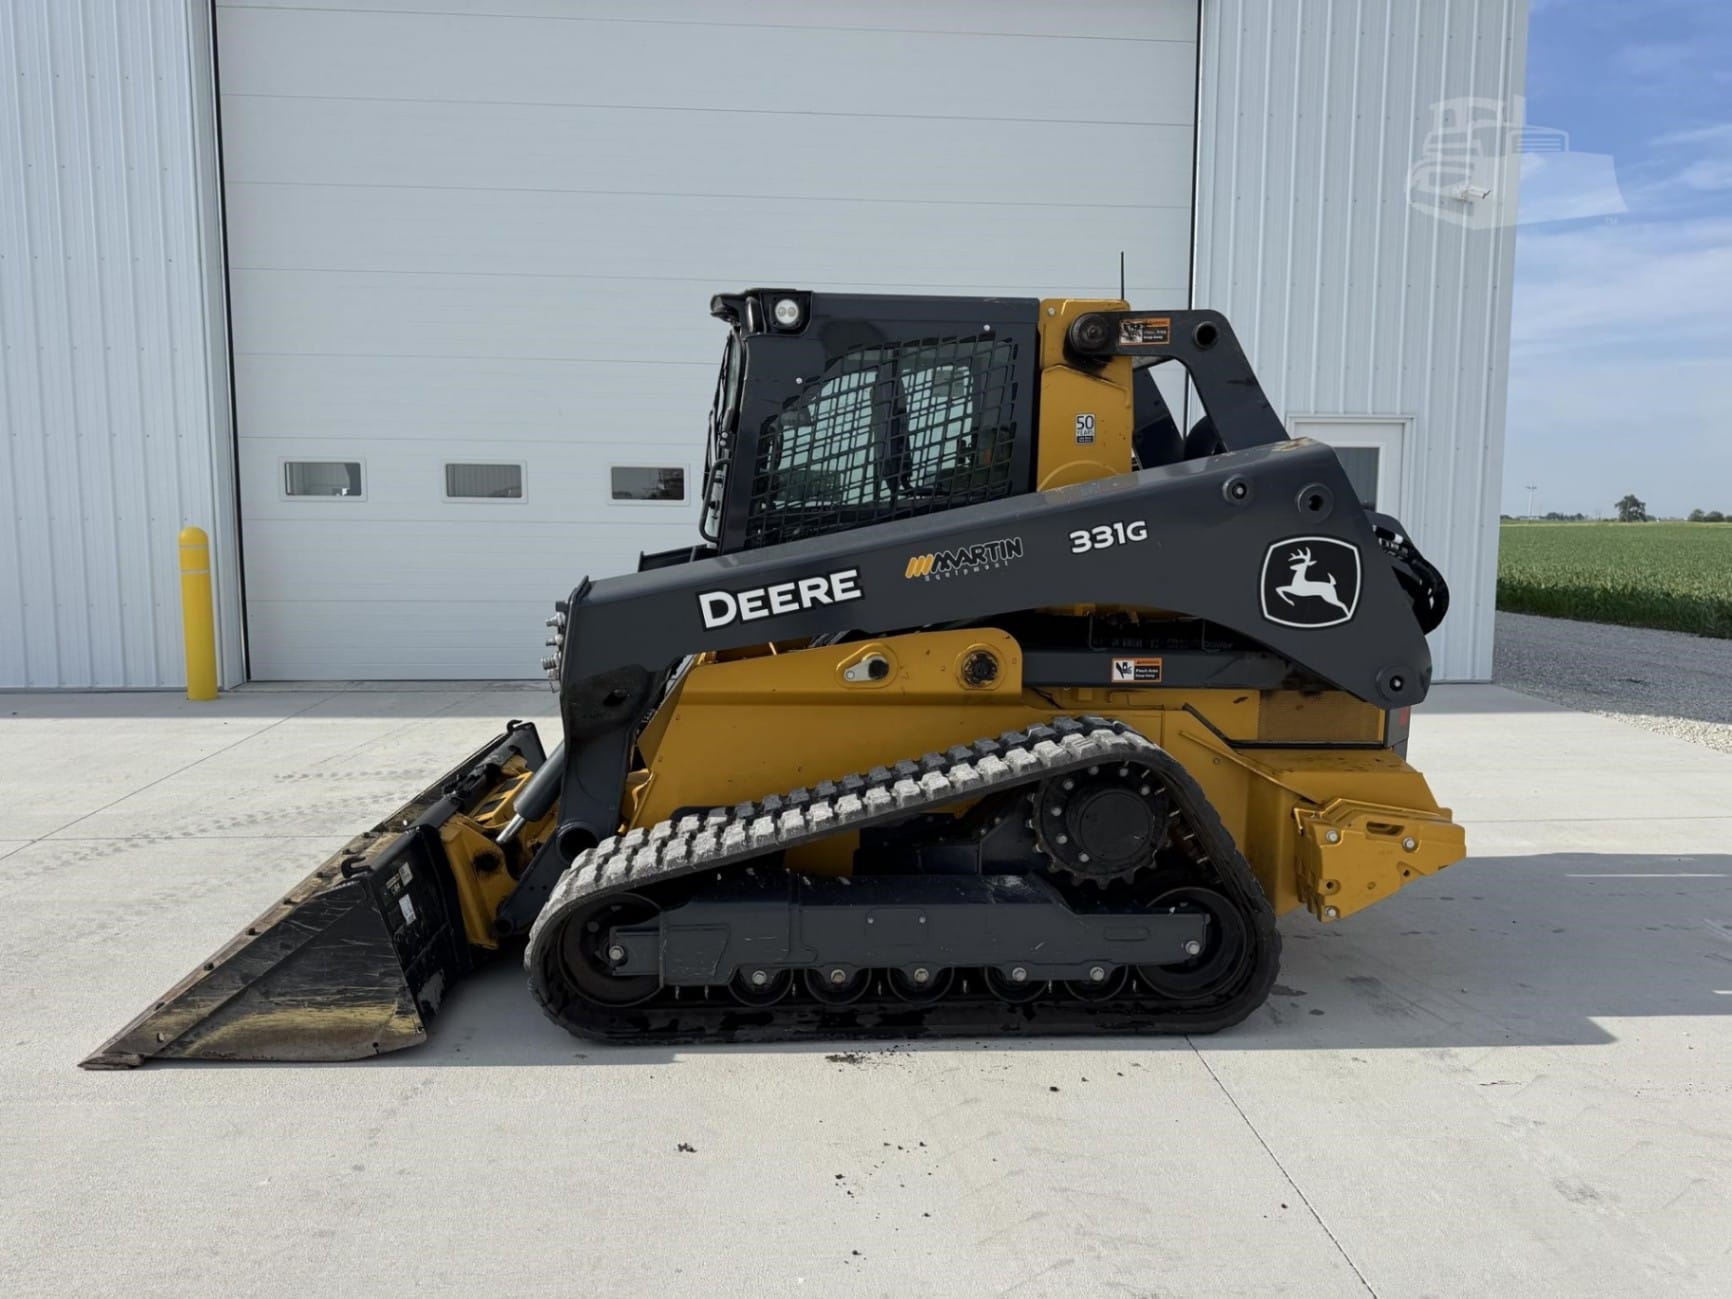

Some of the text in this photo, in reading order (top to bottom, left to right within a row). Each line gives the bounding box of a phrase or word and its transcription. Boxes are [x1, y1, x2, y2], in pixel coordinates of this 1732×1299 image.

[1076, 415, 1094, 430] 50
[1069, 520, 1148, 553] 331G
[930, 537, 1023, 574] MARTIN
[698, 569, 862, 629] DEERE
